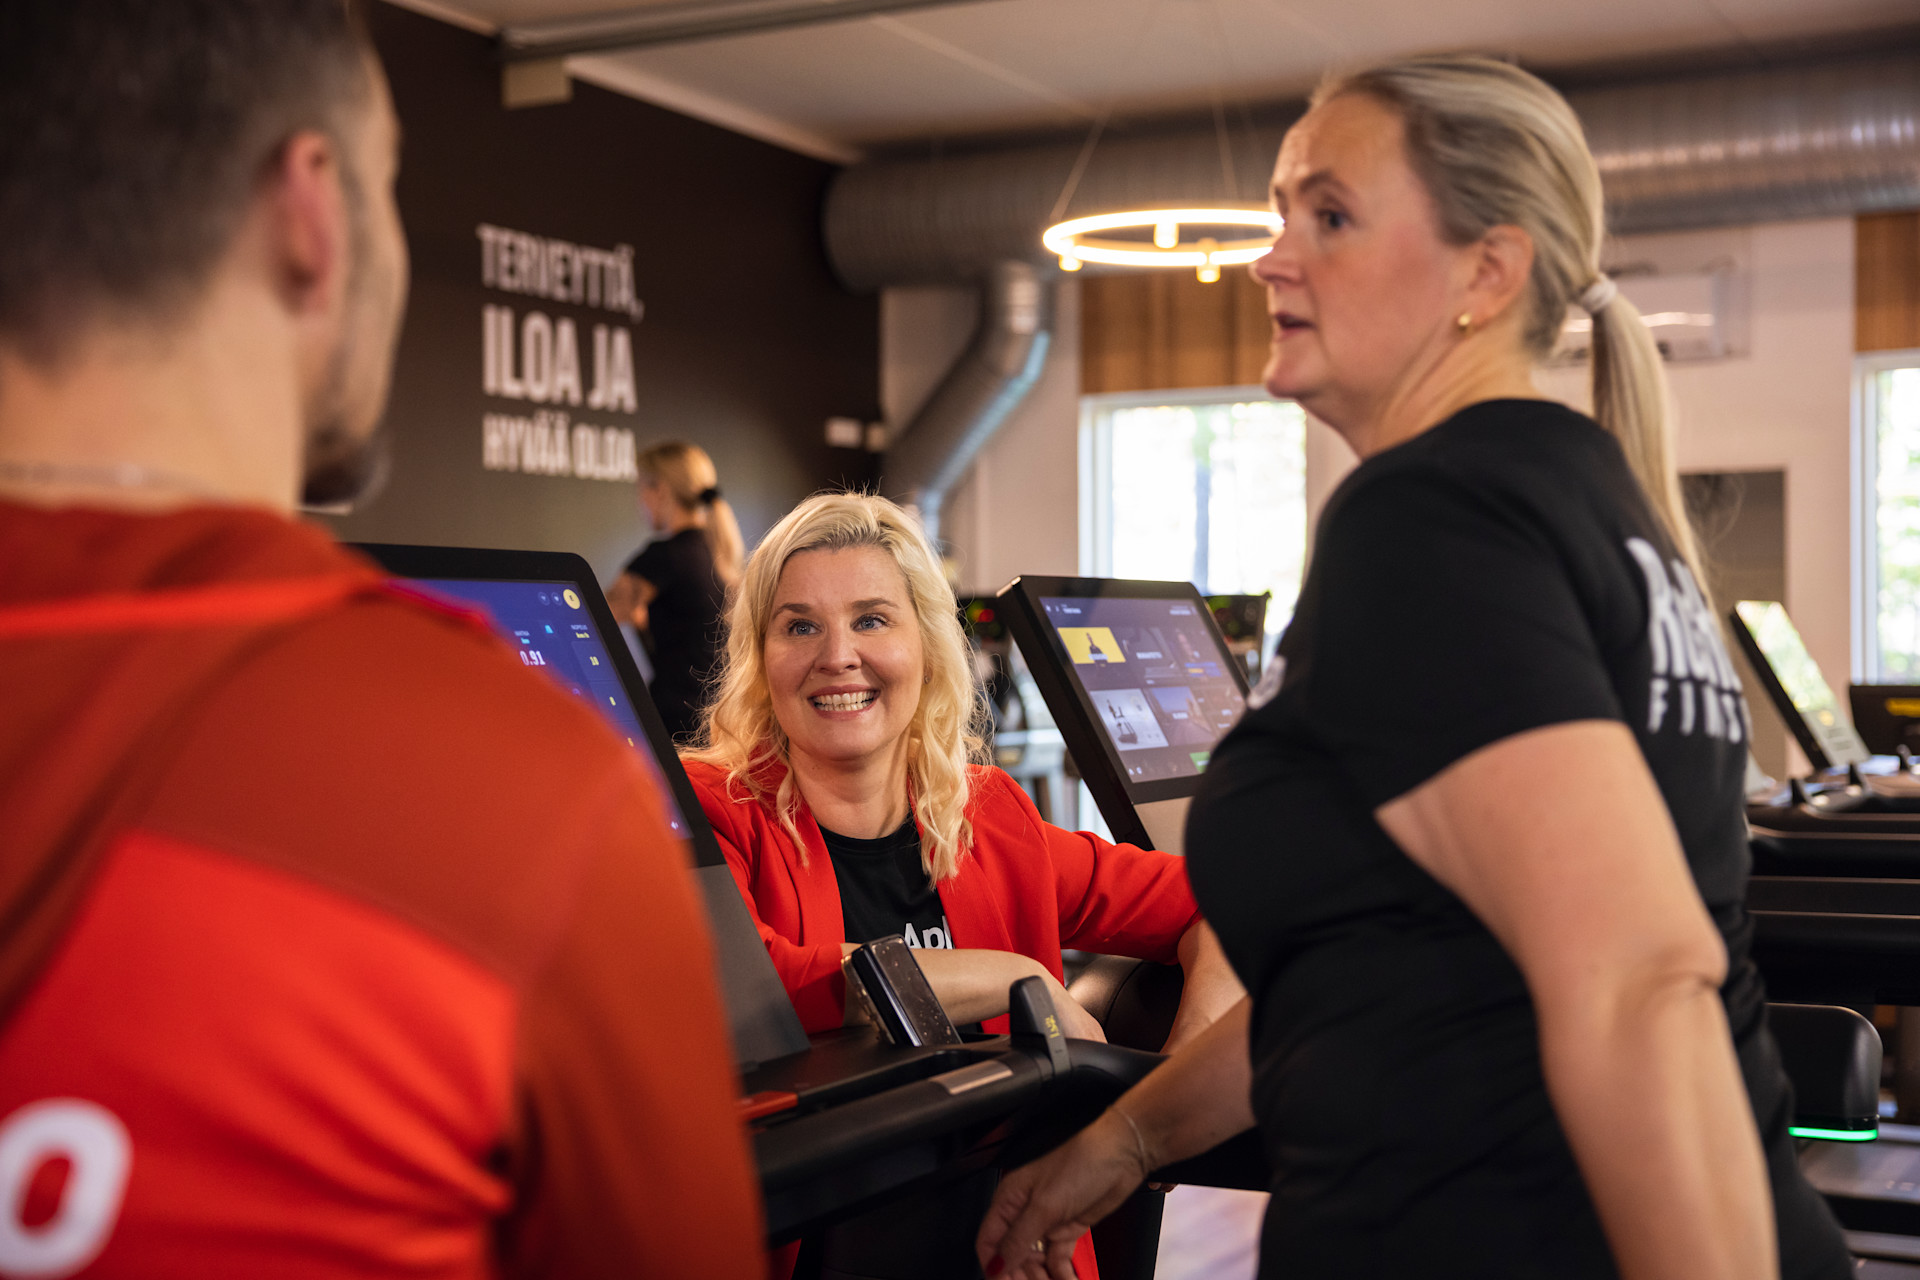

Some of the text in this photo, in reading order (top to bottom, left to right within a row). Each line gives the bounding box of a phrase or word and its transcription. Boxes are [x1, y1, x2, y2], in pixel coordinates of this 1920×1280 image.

[483, 303, 637, 414] ILOA JA
[520, 650, 546, 666] 0.91
